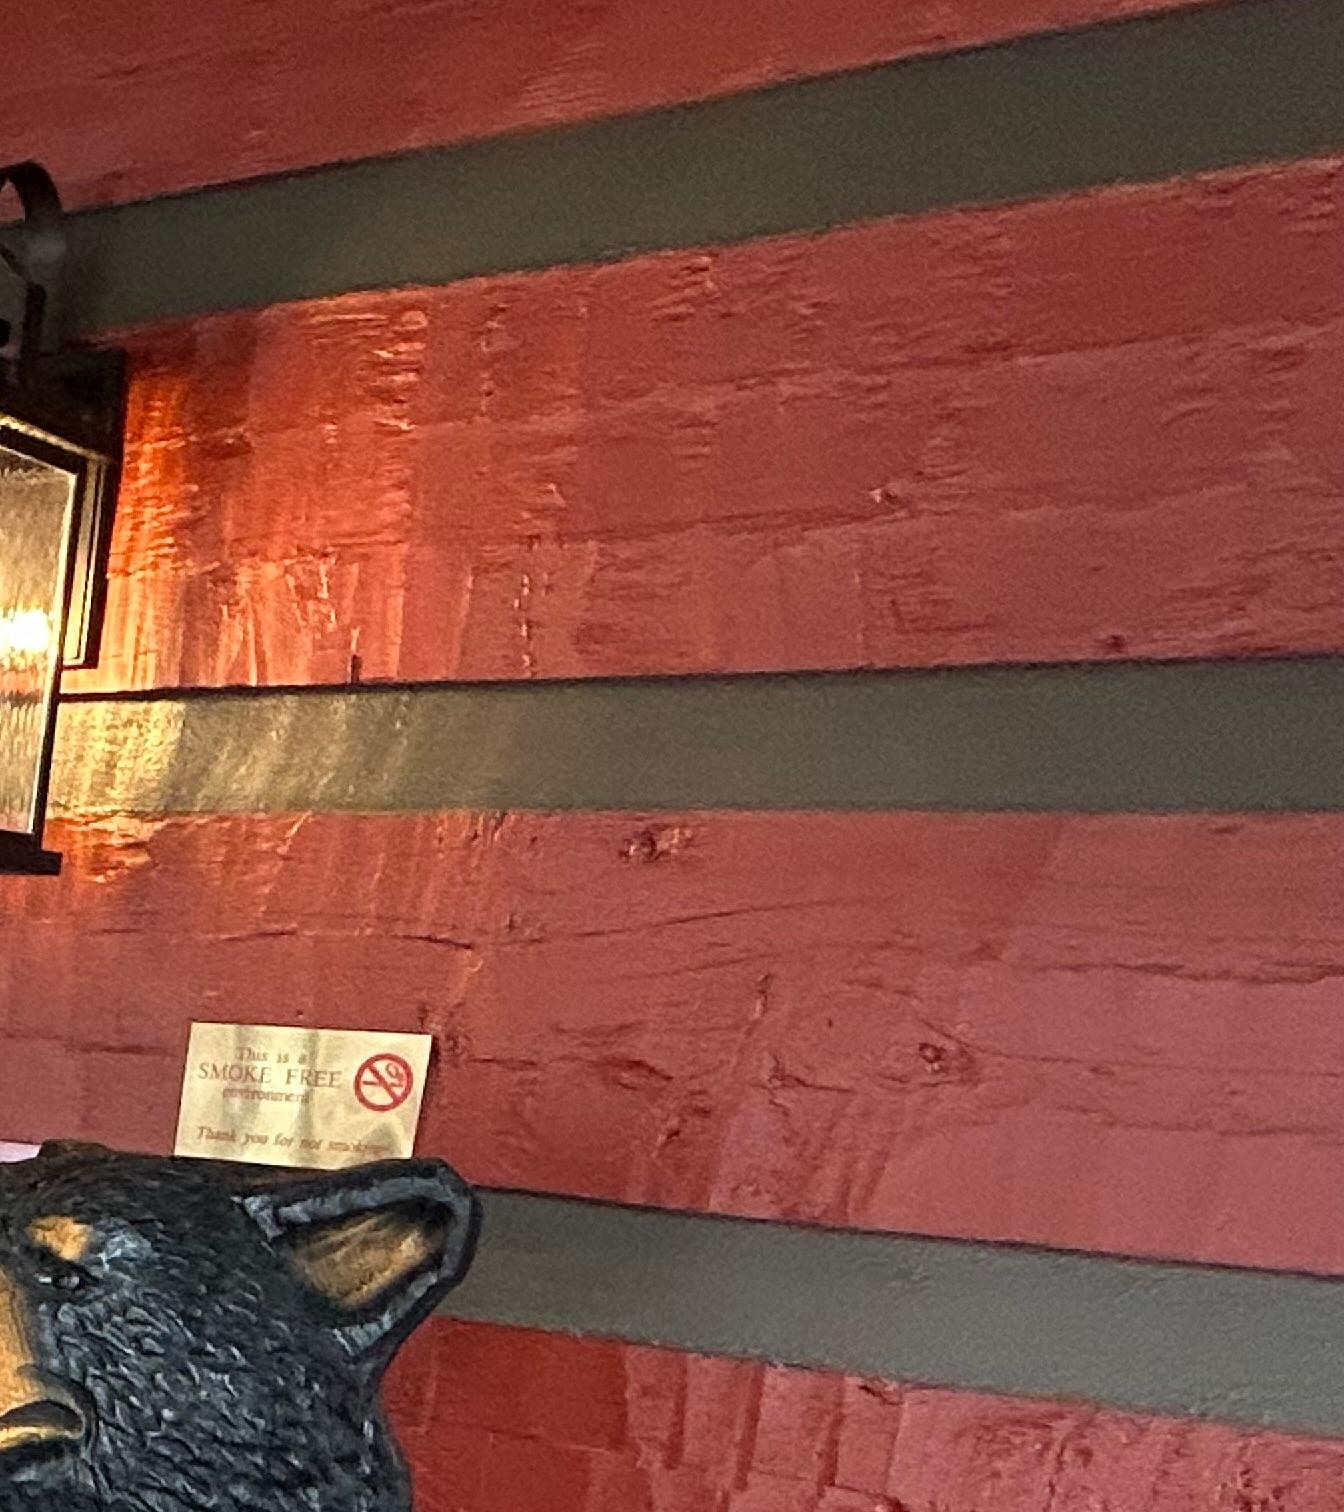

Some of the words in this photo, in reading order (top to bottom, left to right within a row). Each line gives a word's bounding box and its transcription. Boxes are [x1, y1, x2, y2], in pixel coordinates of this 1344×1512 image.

[276, 1050, 290, 1063] is
[198, 1062, 272, 1085] SMOKE
[285, 1068, 343, 1088] FREE
[242, 1133, 268, 1147] you
[273, 1133, 294, 1148] for
